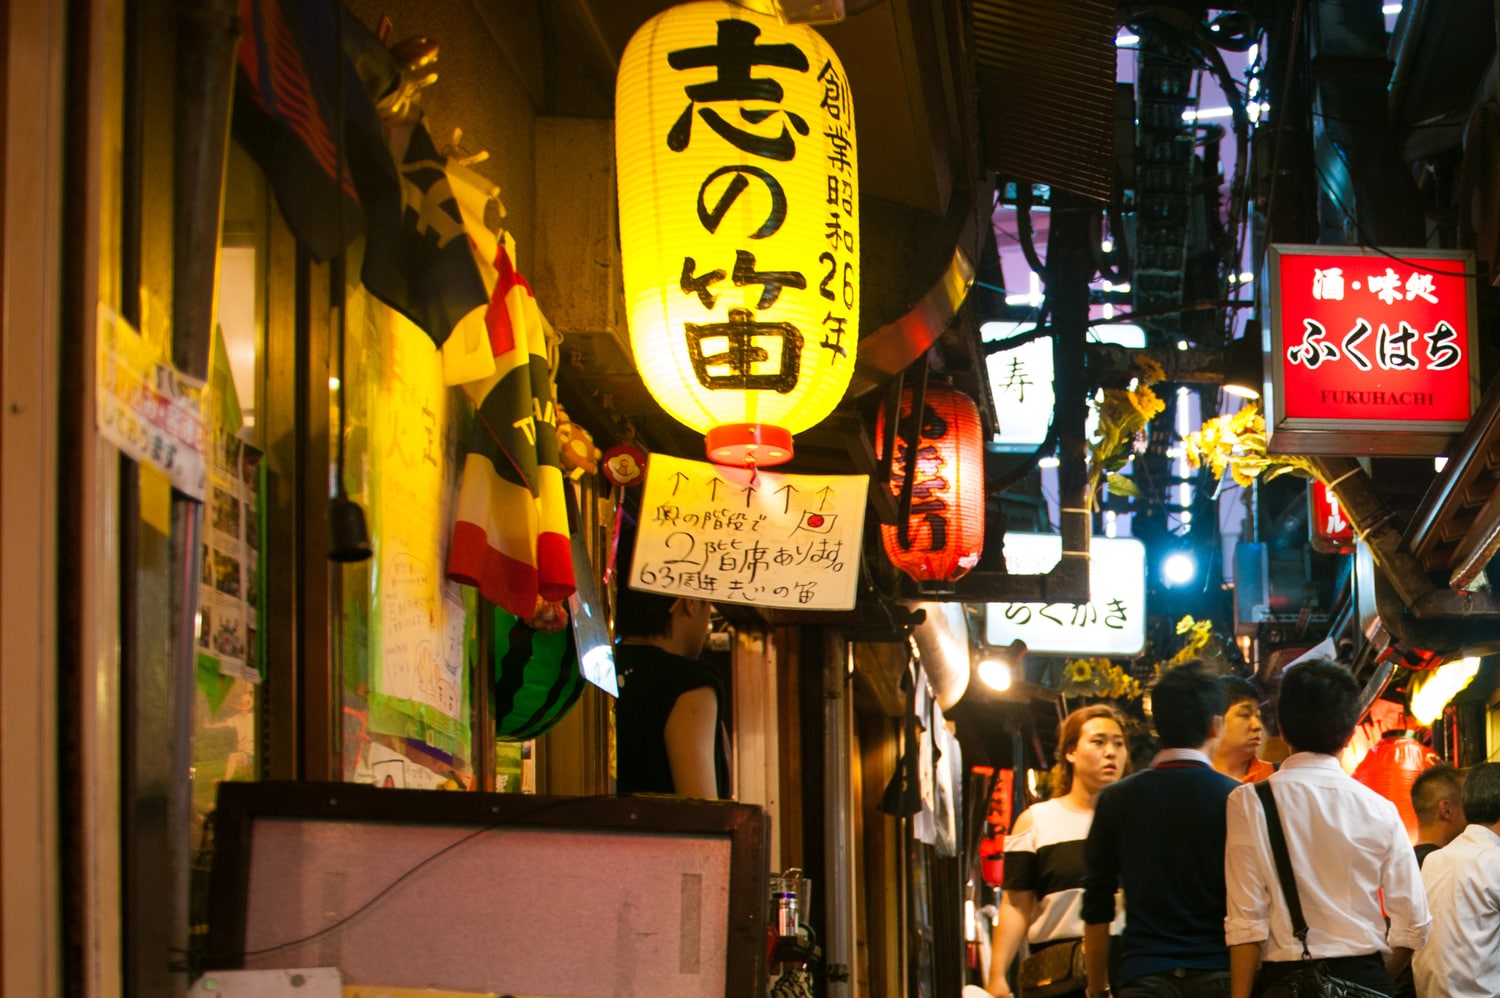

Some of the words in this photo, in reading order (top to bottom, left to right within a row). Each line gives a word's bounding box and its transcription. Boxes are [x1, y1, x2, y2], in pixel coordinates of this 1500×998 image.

[667, 19, 809, 394] 志の笛
[1312, 267, 1439, 305] 酒・味処
[1287, 317, 1462, 371] ふくはち
[998, 357, 1033, 403] 寿
[1321, 390, 1434, 406] FUKUHACHI
[653, 503, 767, 532] 奥の階段で
[639, 561, 718, 593] 63周年
